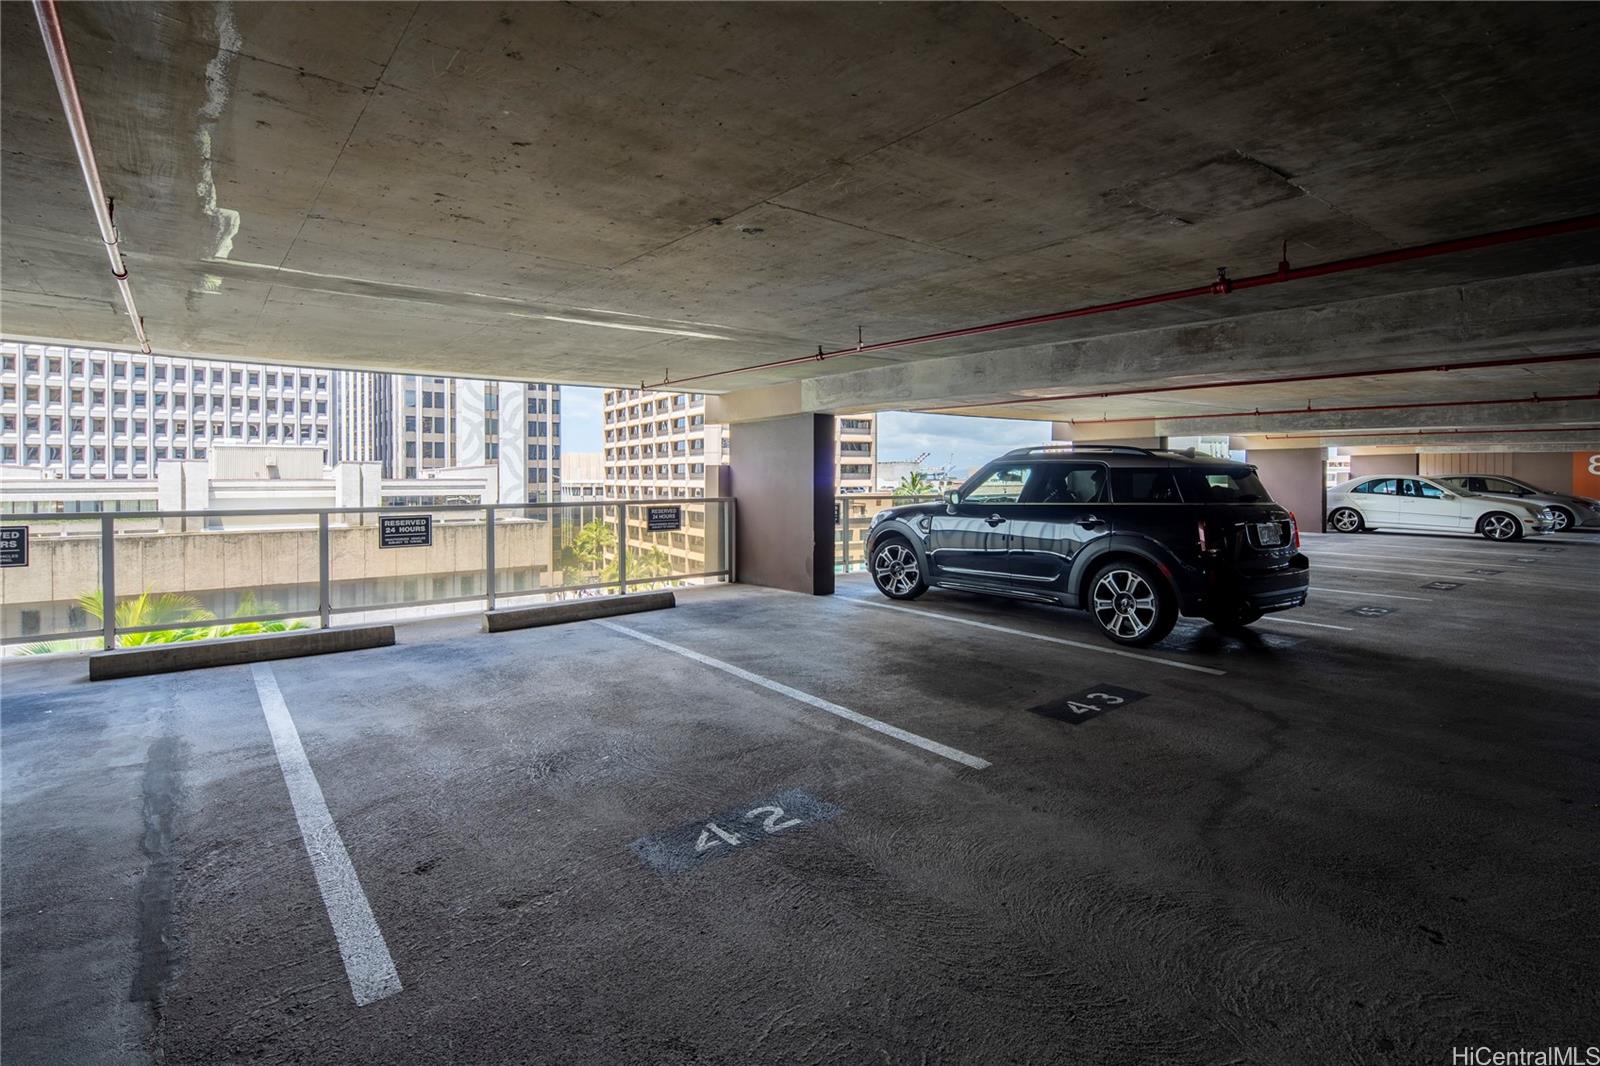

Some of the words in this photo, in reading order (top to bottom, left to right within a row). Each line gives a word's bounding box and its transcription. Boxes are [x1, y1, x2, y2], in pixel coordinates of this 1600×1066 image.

[384, 519, 427, 527] RESERVED
[399, 525, 426, 533] HOURS
[1066, 692, 1124, 714] 43
[695, 806, 803, 851] 42
